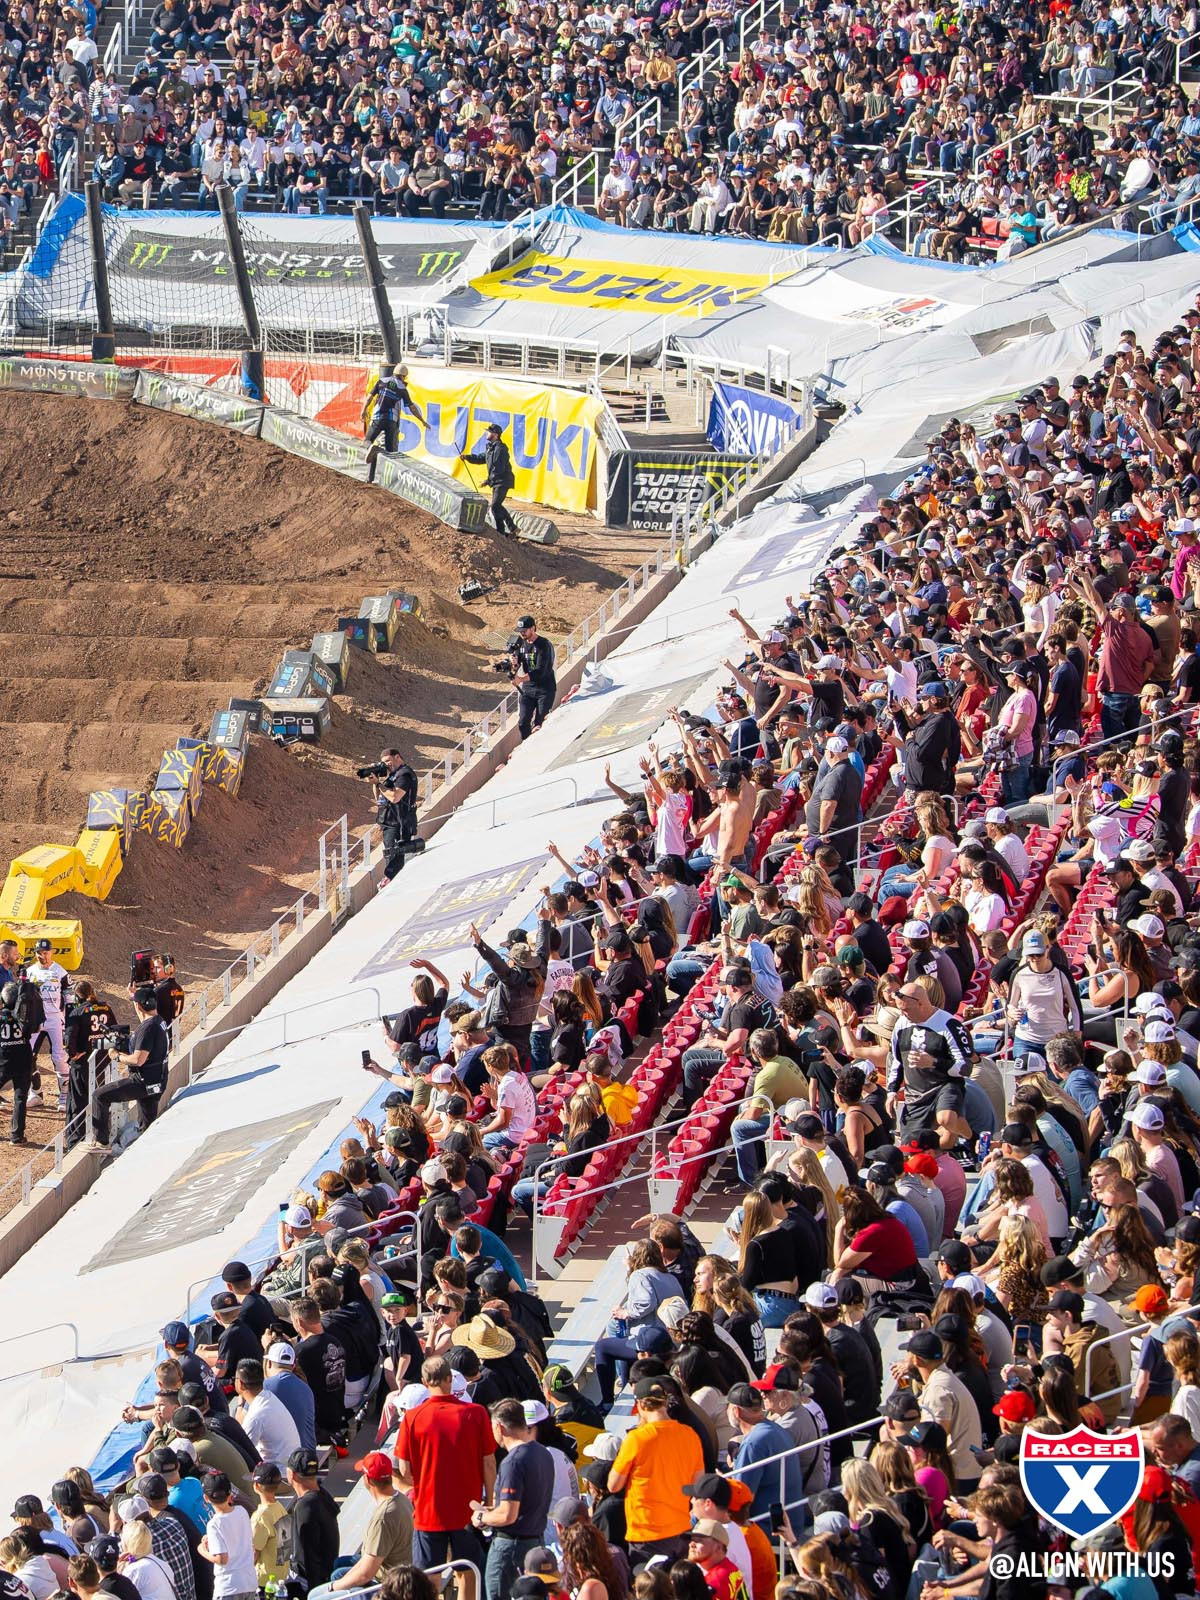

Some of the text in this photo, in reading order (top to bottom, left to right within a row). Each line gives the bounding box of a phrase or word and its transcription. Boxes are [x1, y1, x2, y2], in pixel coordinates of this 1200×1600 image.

[501, 263, 756, 307] SUZUK
[20, 365, 96, 383] MONSTER
[32, 382, 87, 391] ENERGY
[166, 387, 228, 413] MONSTER
[287, 426, 342, 457] MONSTER
[399, 402, 590, 480] SUZUKI
[397, 470, 443, 500] MONSTER
[633, 473, 707, 486] SUPER
[637, 487, 703, 500] MOTO
[632, 500, 704, 514] CROSS
[632, 520, 674, 531] WORLD
[285, 667, 304, 694] GoPro
[315, 662, 333, 685] GoPro
[230, 713, 240, 743] GoPro
[272, 716, 313, 725] oPro
[11, 884, 27, 917] DUNLOP
[747, 993, 766, 1010] WEB
[0, 1021, 23, 1040] 03
[956, 1026, 971, 1054] FOX
[0, 1040, 24, 1048] peacock
